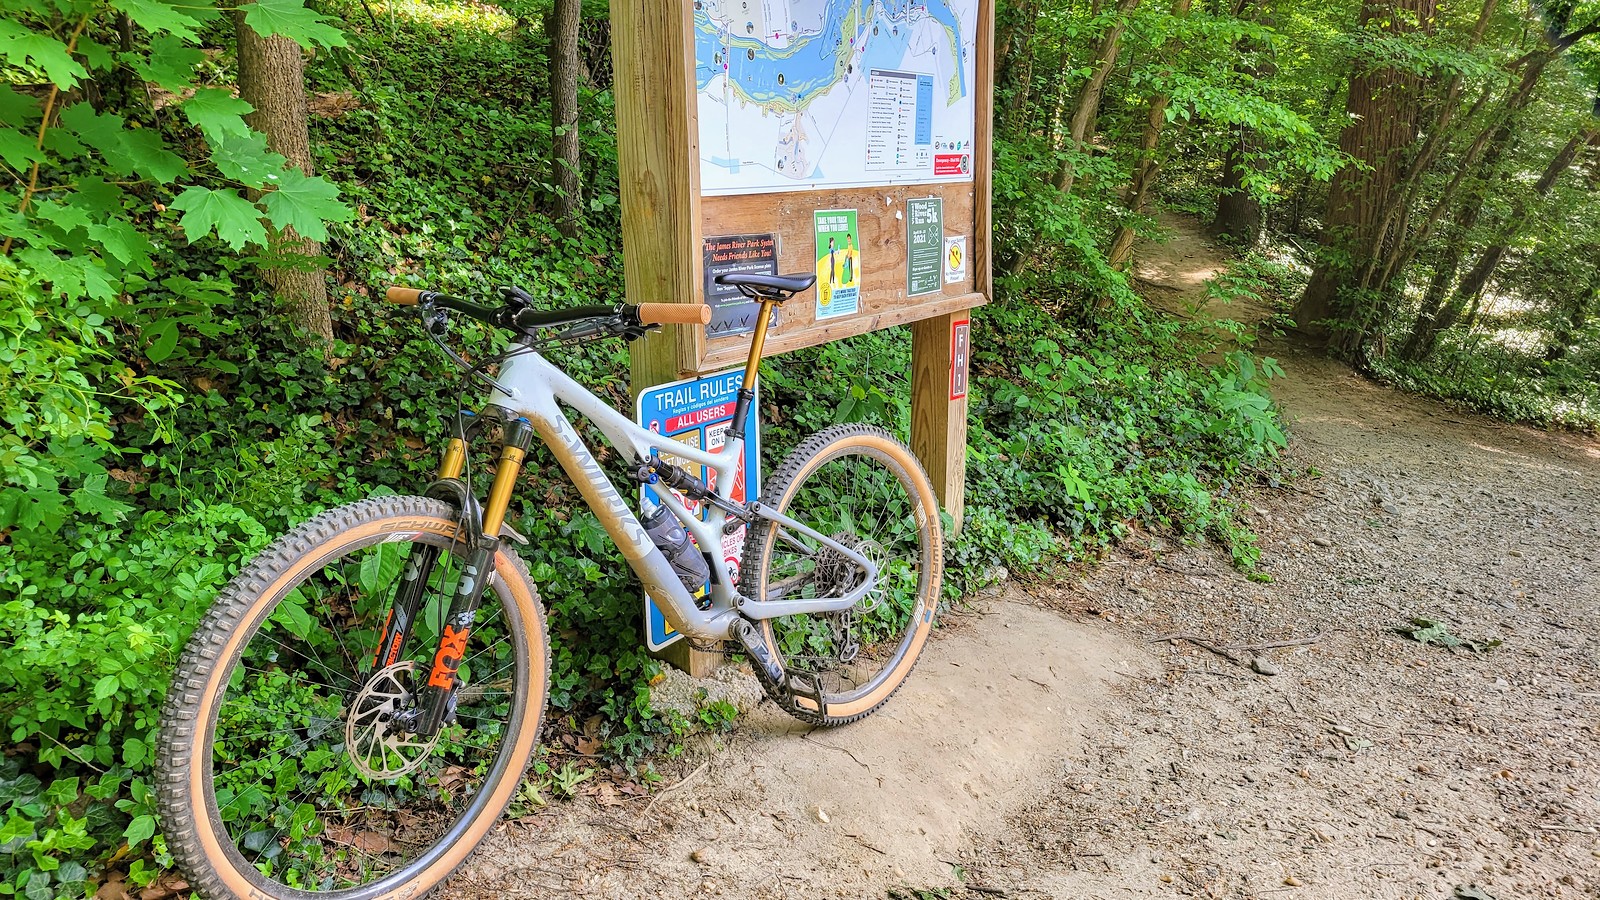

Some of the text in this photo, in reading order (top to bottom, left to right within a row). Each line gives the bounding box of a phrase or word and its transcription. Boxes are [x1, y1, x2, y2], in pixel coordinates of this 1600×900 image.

[926, 207, 938, 224] 5k
[705, 242, 716, 251] The
[716, 242, 731, 252] James
[732, 241, 746, 249] River
[747, 240, 759, 248] Park
[914, 234, 926, 244] 2021
[712, 253, 727, 262] Needs
[728, 251, 748, 260] Friends
[749, 250, 760, 258] Like
[655, 374, 743, 411] TRAIL RULES
[673, 407, 686, 415] Reglas
[677, 405, 726, 428] ALL USERS
[708, 427, 724, 438] KEEP
[712, 436, 718, 446] ON
[722, 534, 744, 548] ICLES OR
[928, 514, 939, 609] SCHWALBE
[385, 632, 402, 667] FACTORY
[428, 624, 470, 690] FOX
